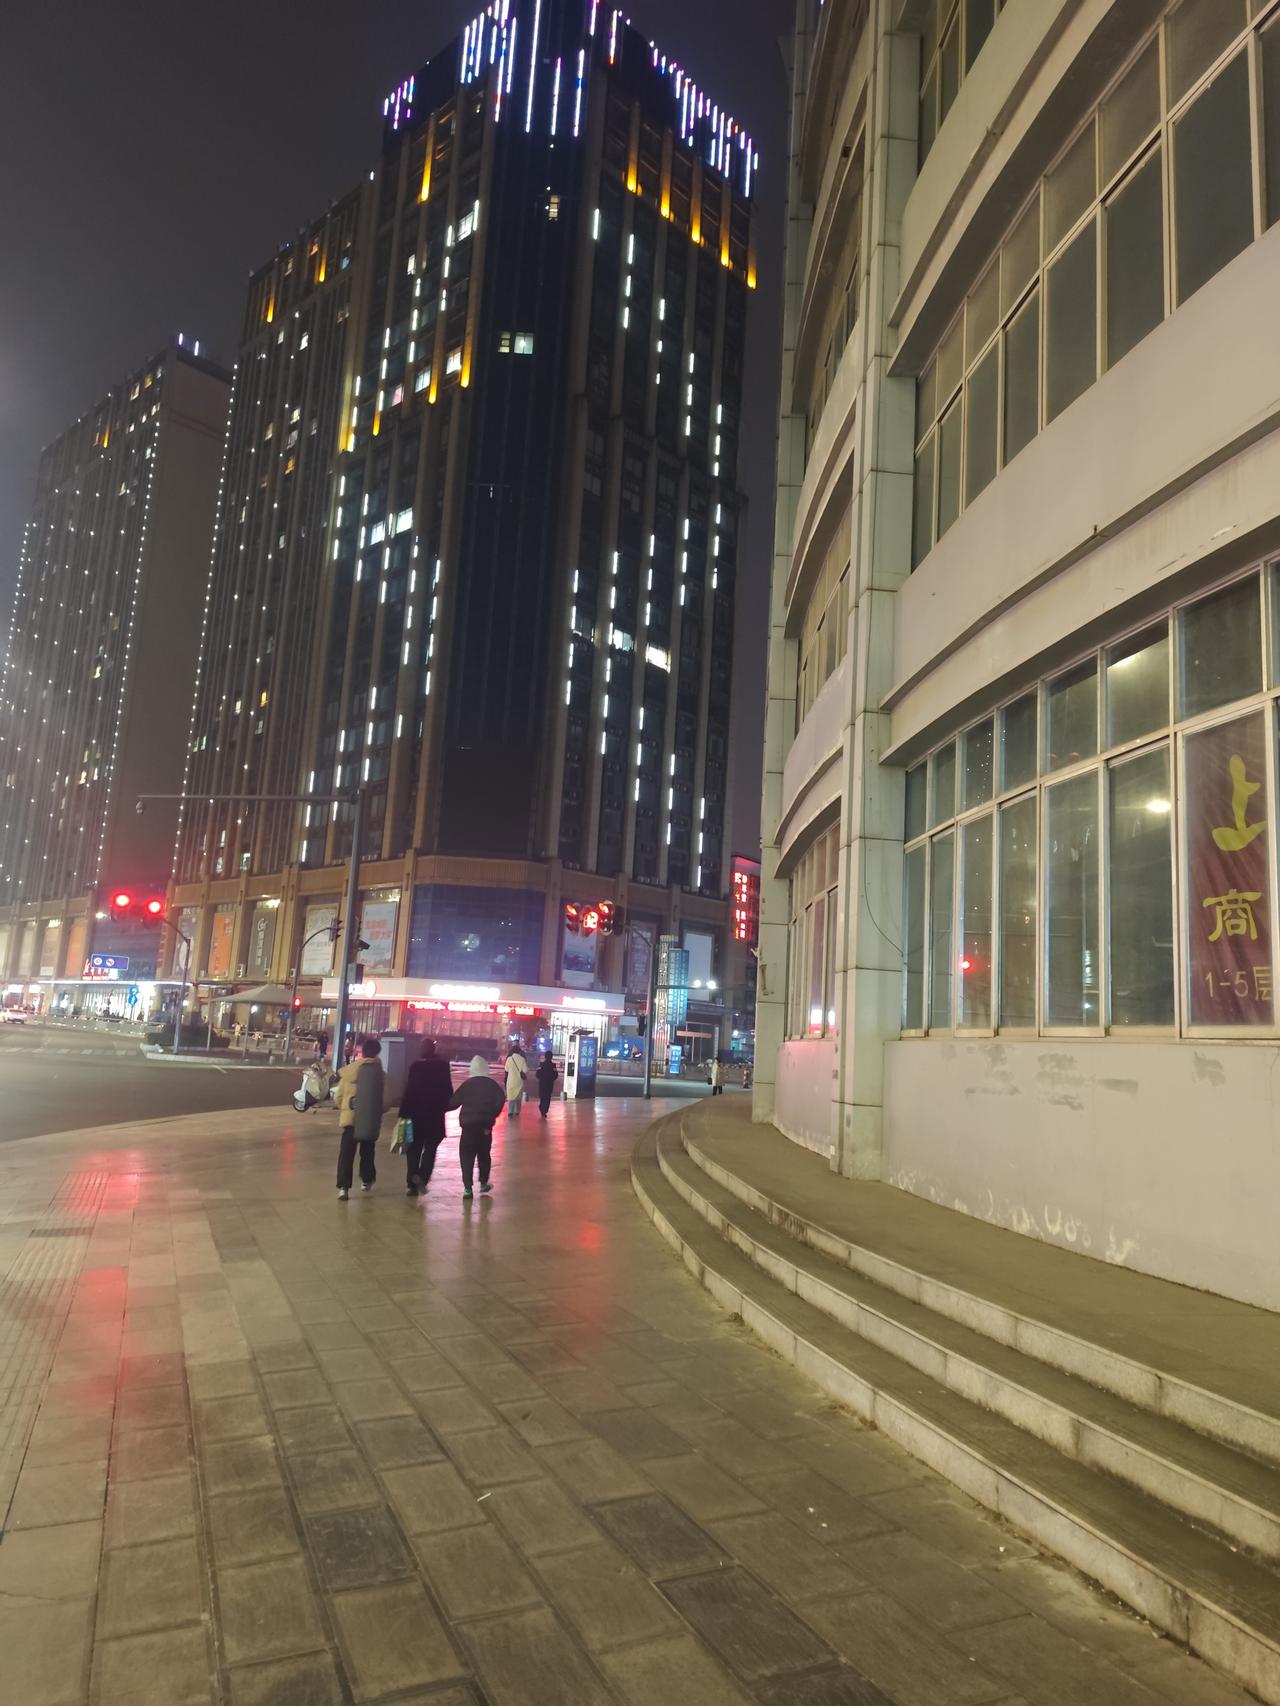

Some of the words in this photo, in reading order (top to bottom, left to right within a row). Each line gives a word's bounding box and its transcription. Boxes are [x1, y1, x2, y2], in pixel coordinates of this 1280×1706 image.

[1212, 754, 1268, 851] 上
[1203, 888, 1262, 942] 商
[1205, 966, 1273, 1001] 1-5层
